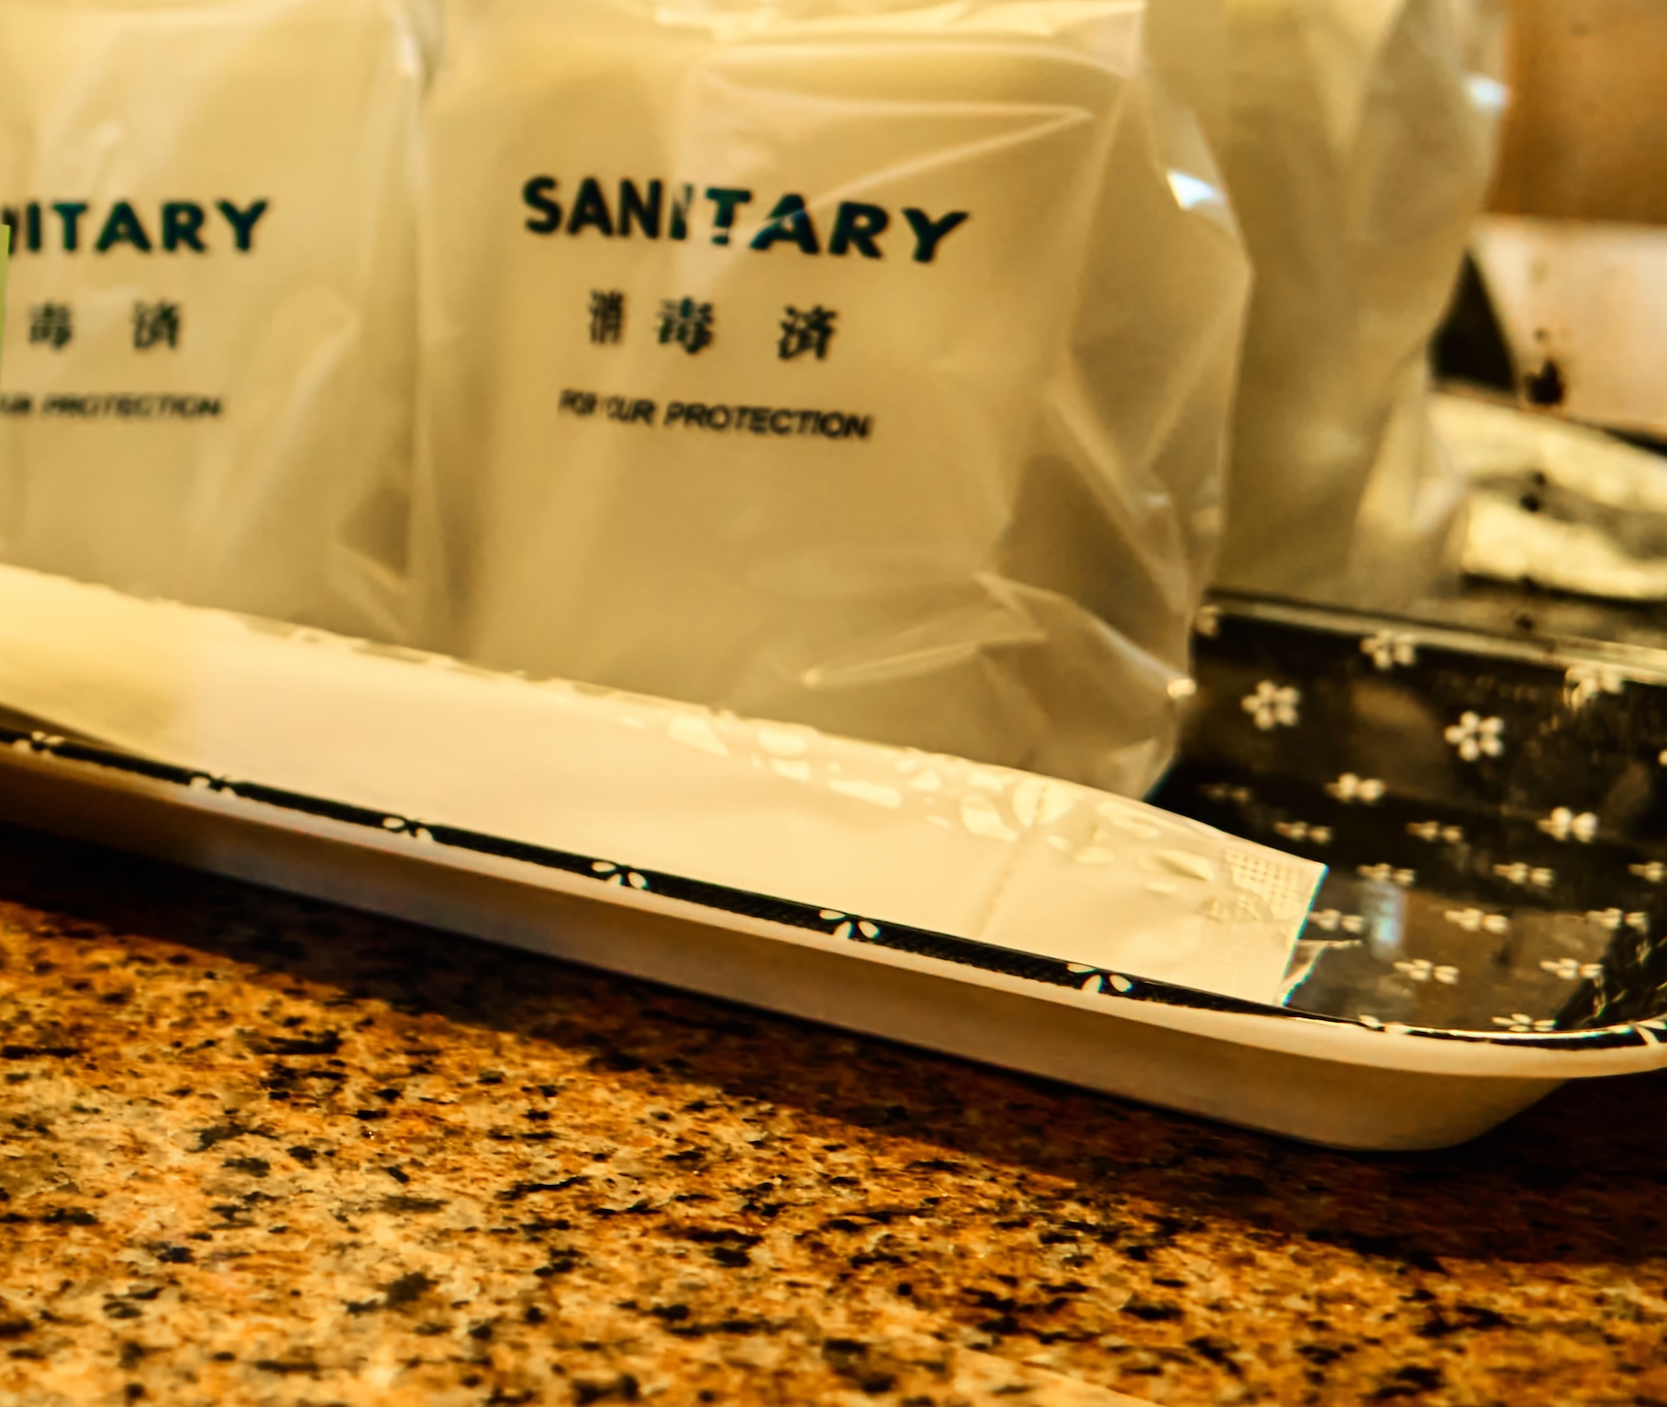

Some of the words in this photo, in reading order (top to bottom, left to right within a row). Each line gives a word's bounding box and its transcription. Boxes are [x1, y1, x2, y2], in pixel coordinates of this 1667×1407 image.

[522, 175, 970, 263] SANITARY
[601, 397, 656, 426] OUR
[664, 402, 874, 439] PROTECTION
